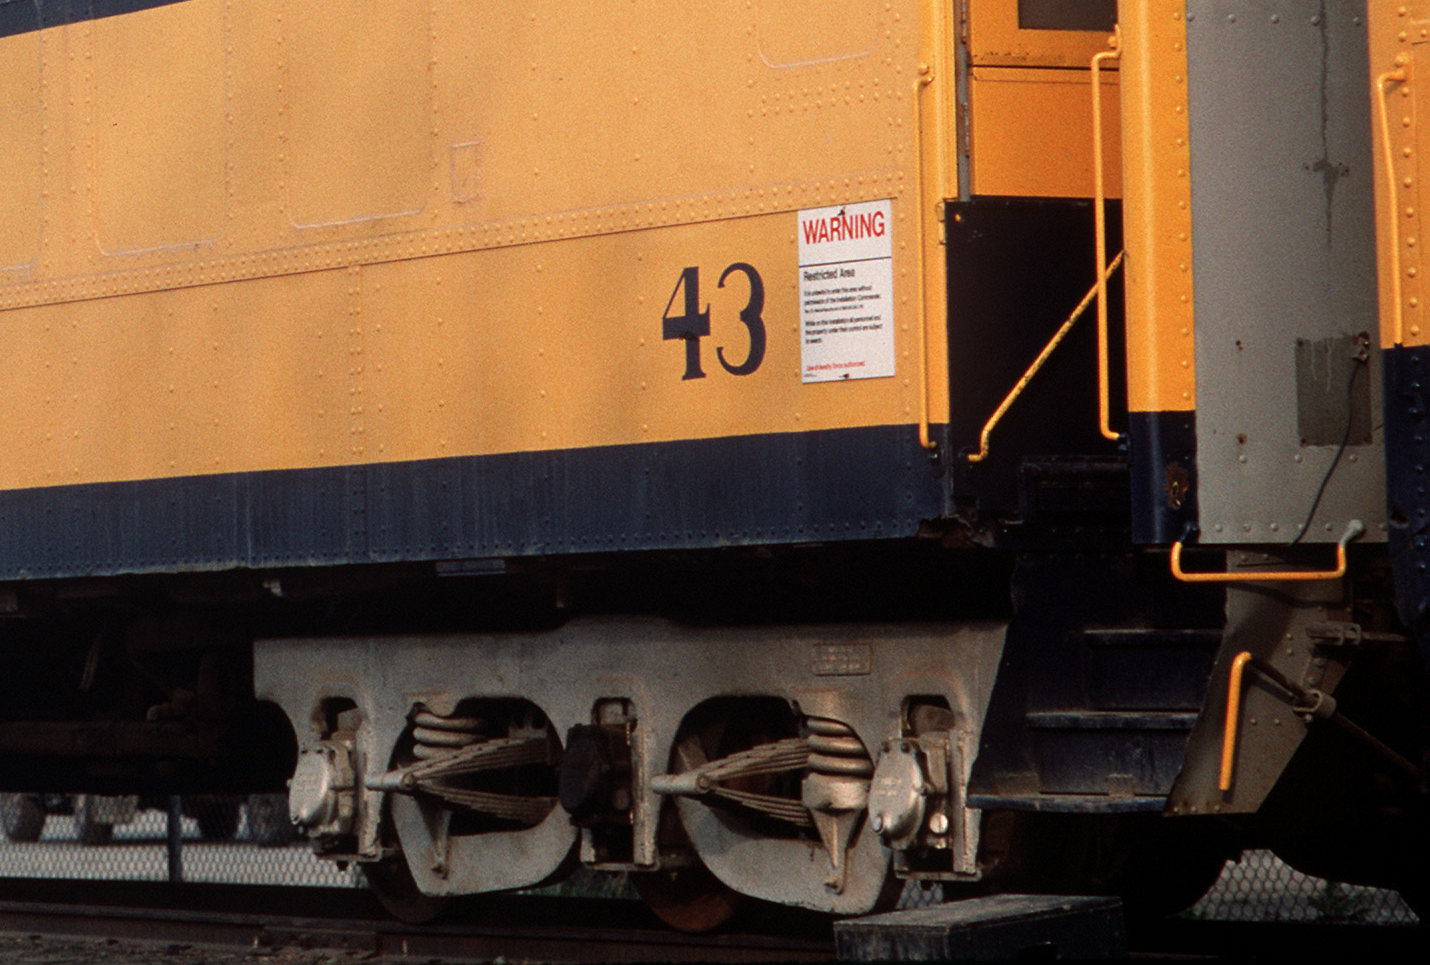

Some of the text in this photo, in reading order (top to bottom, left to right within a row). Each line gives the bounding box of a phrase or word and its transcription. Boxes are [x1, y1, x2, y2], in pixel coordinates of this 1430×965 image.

[803, 210, 885, 245] WARNING
[839, 268, 855, 278] Area
[662, 262, 766, 380] 43
